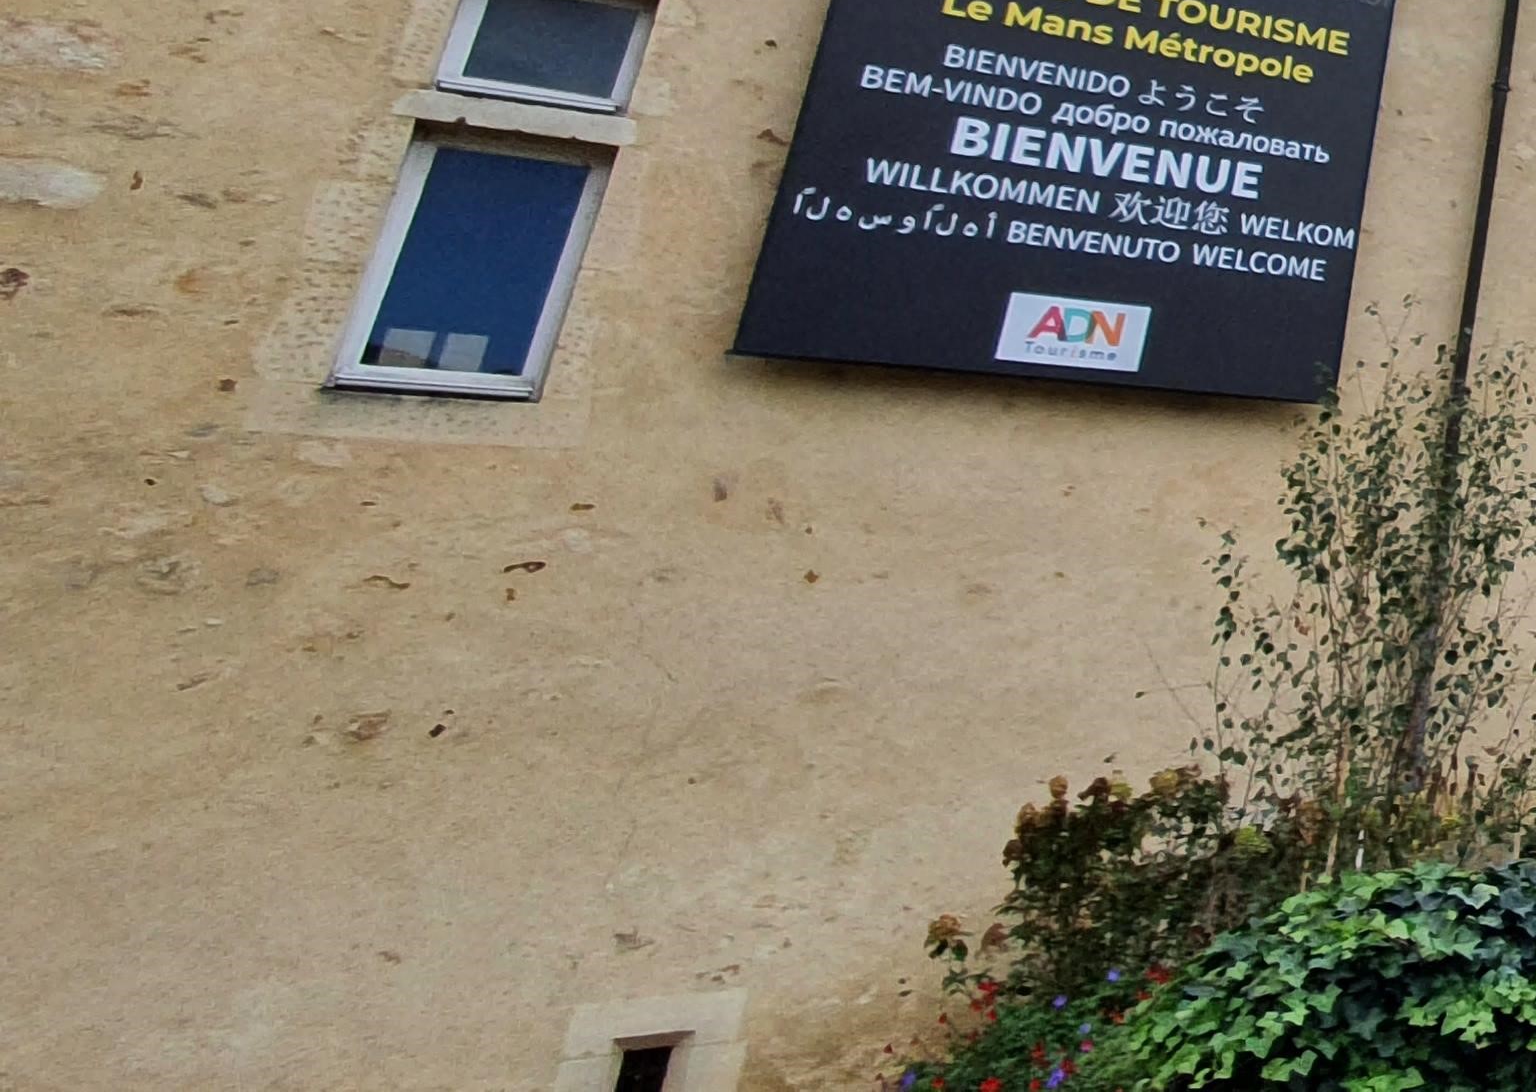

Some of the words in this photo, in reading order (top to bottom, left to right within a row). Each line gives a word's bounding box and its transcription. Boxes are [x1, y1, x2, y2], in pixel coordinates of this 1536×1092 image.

[1004, 1, 1114, 46] Mans
[1123, 25, 1314, 84] Métropole
[860, 64, 1043, 116] BEM-VINDO
[1052, 102, 1150, 136] добро
[1159, 119, 1331, 165] пожаловать
[943, 44, 1131, 98] BIENVENIDO
[1138, 79, 1265, 124] ようこそ
[950, 116, 1264, 200] BIENVENUE
[866, 157, 1101, 215] WILLKOMMEN
[1108, 191, 1231, 236] 欢迎您
[1240, 212, 1355, 250] WELKOM
[1006, 219, 1181, 263] BENVENUTO
[1192, 243, 1327, 281] WELCOME
[1024, 340, 1117, 361] Tourisme
[1026, 305, 1126, 347] ADN
